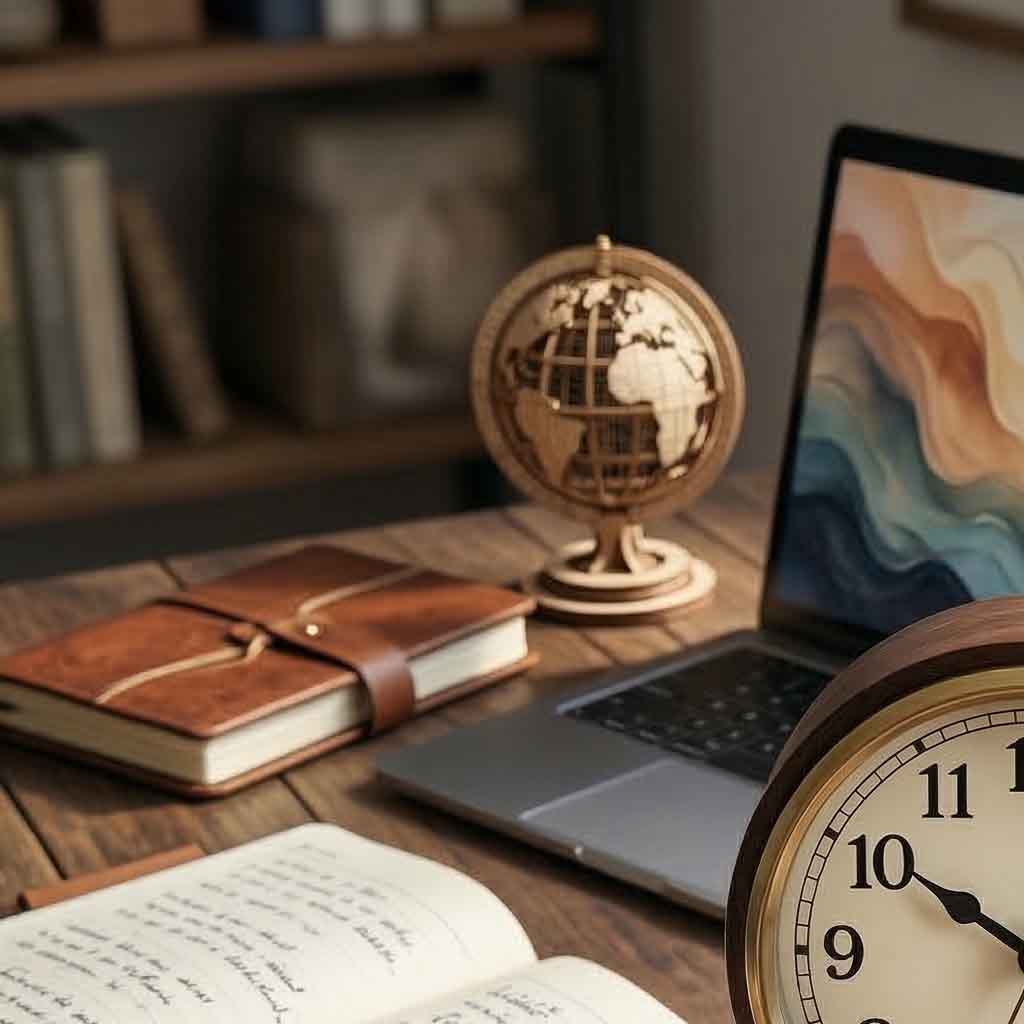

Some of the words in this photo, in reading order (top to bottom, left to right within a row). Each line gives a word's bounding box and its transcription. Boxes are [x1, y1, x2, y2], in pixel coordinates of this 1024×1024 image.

[918, 763, 974, 819] 11
[848, 834, 915, 890] 10
[823, 925, 864, 980] 9
